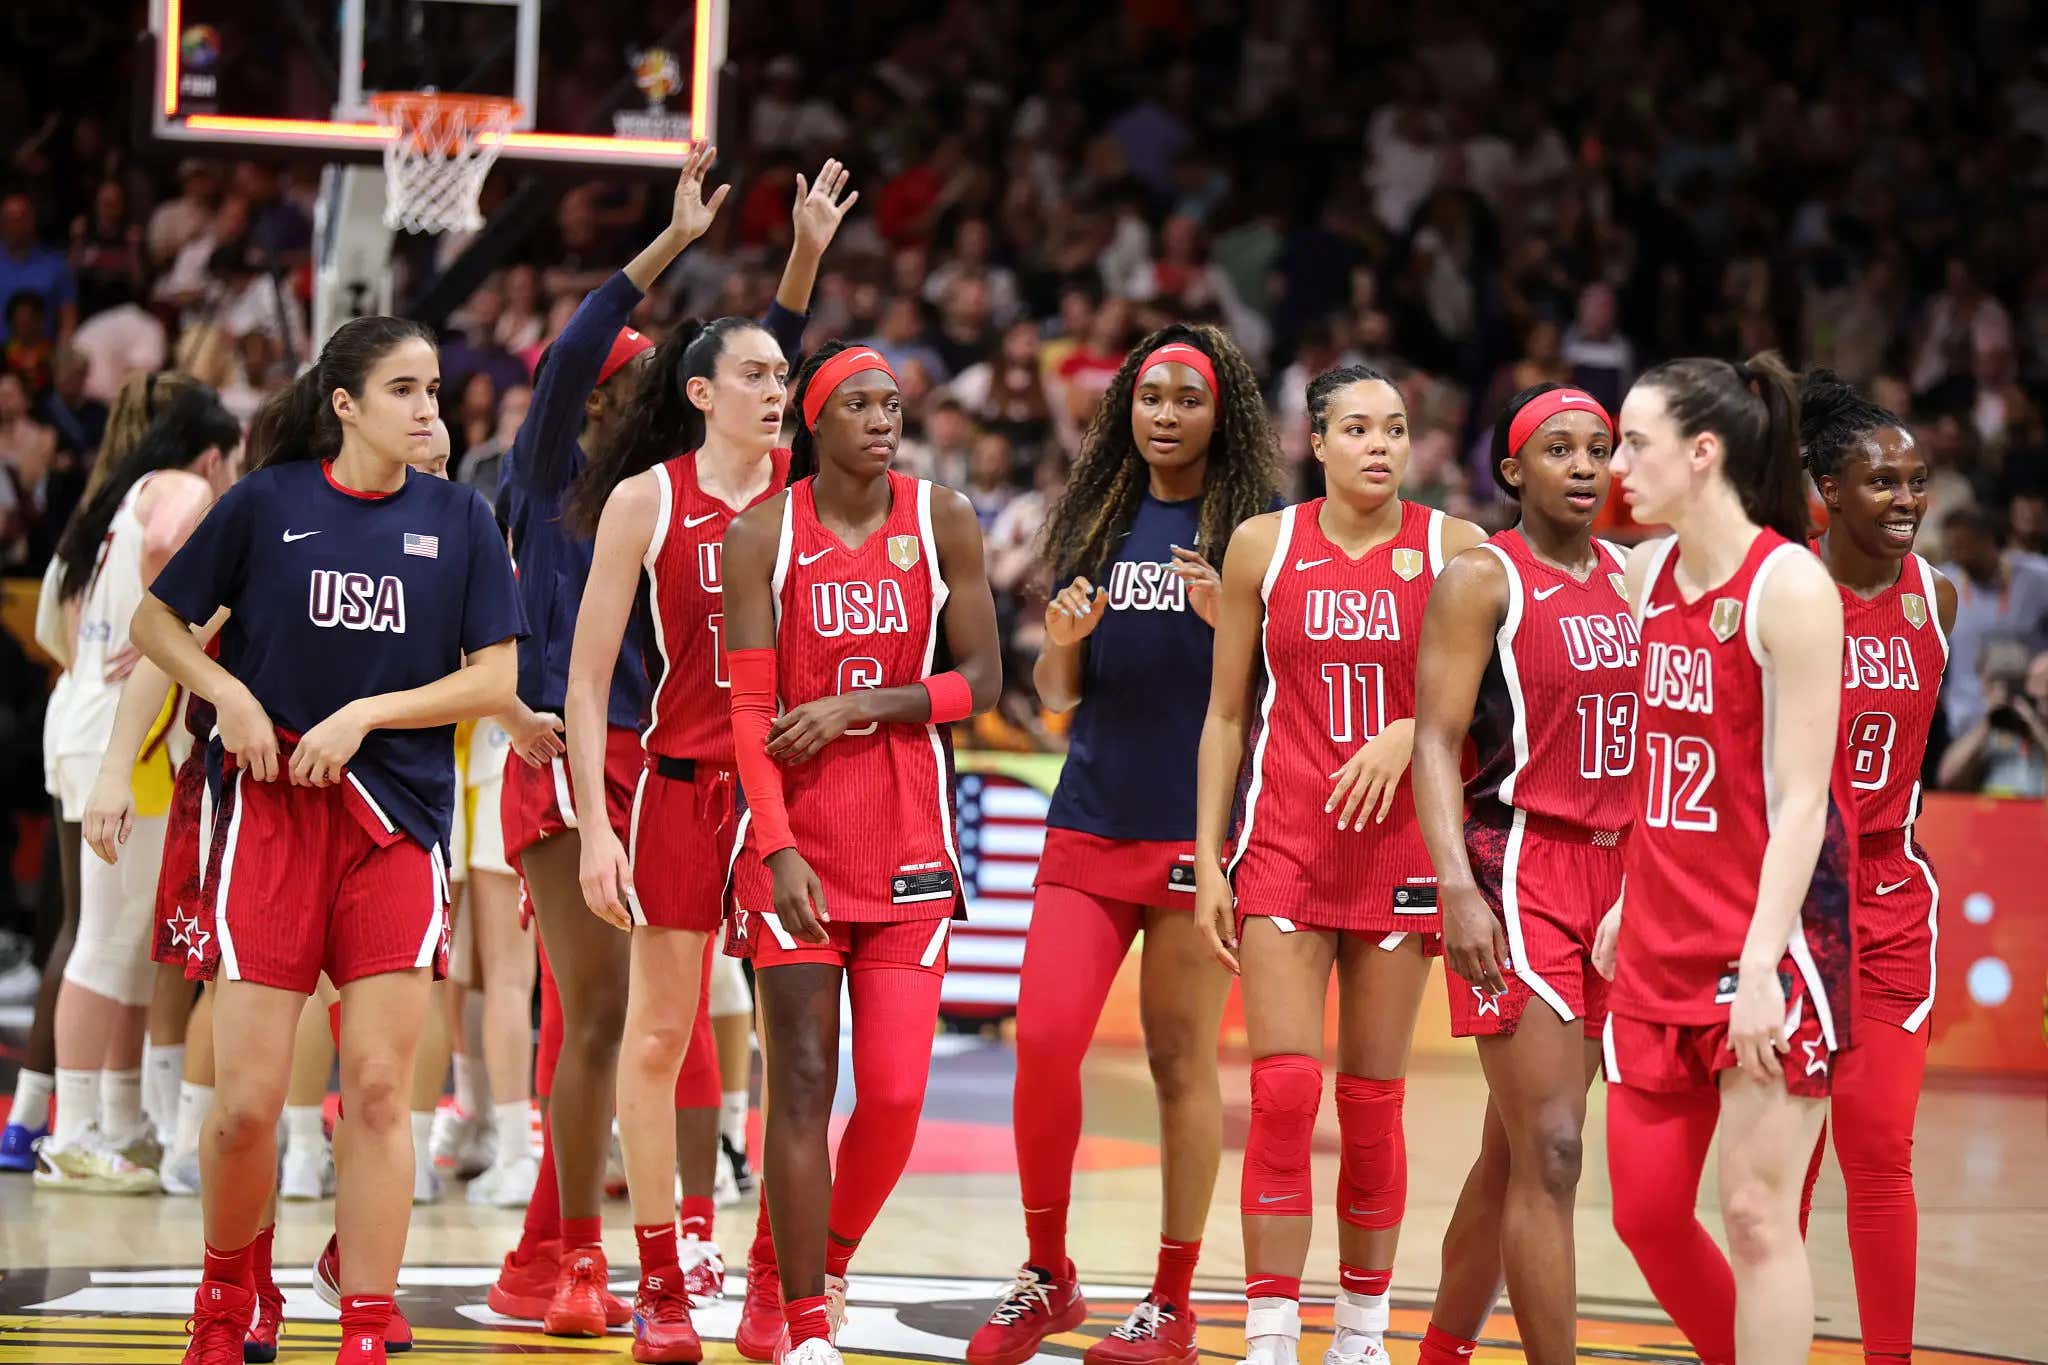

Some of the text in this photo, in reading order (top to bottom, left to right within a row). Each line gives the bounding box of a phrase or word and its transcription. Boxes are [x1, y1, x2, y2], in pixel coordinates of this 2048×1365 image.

[310, 569, 406, 633] USA
[811, 579, 908, 637] USA
[1108, 562, 1185, 612] USA
[1305, 590, 1400, 641] USA
[1559, 612, 1640, 671] USA
[1322, 663, 1385, 743] 11
[1644, 642, 1713, 714] USA
[1577, 692, 1638, 779] 13
[1847, 712, 1896, 790] 8
[1646, 732, 1718, 832] 12
